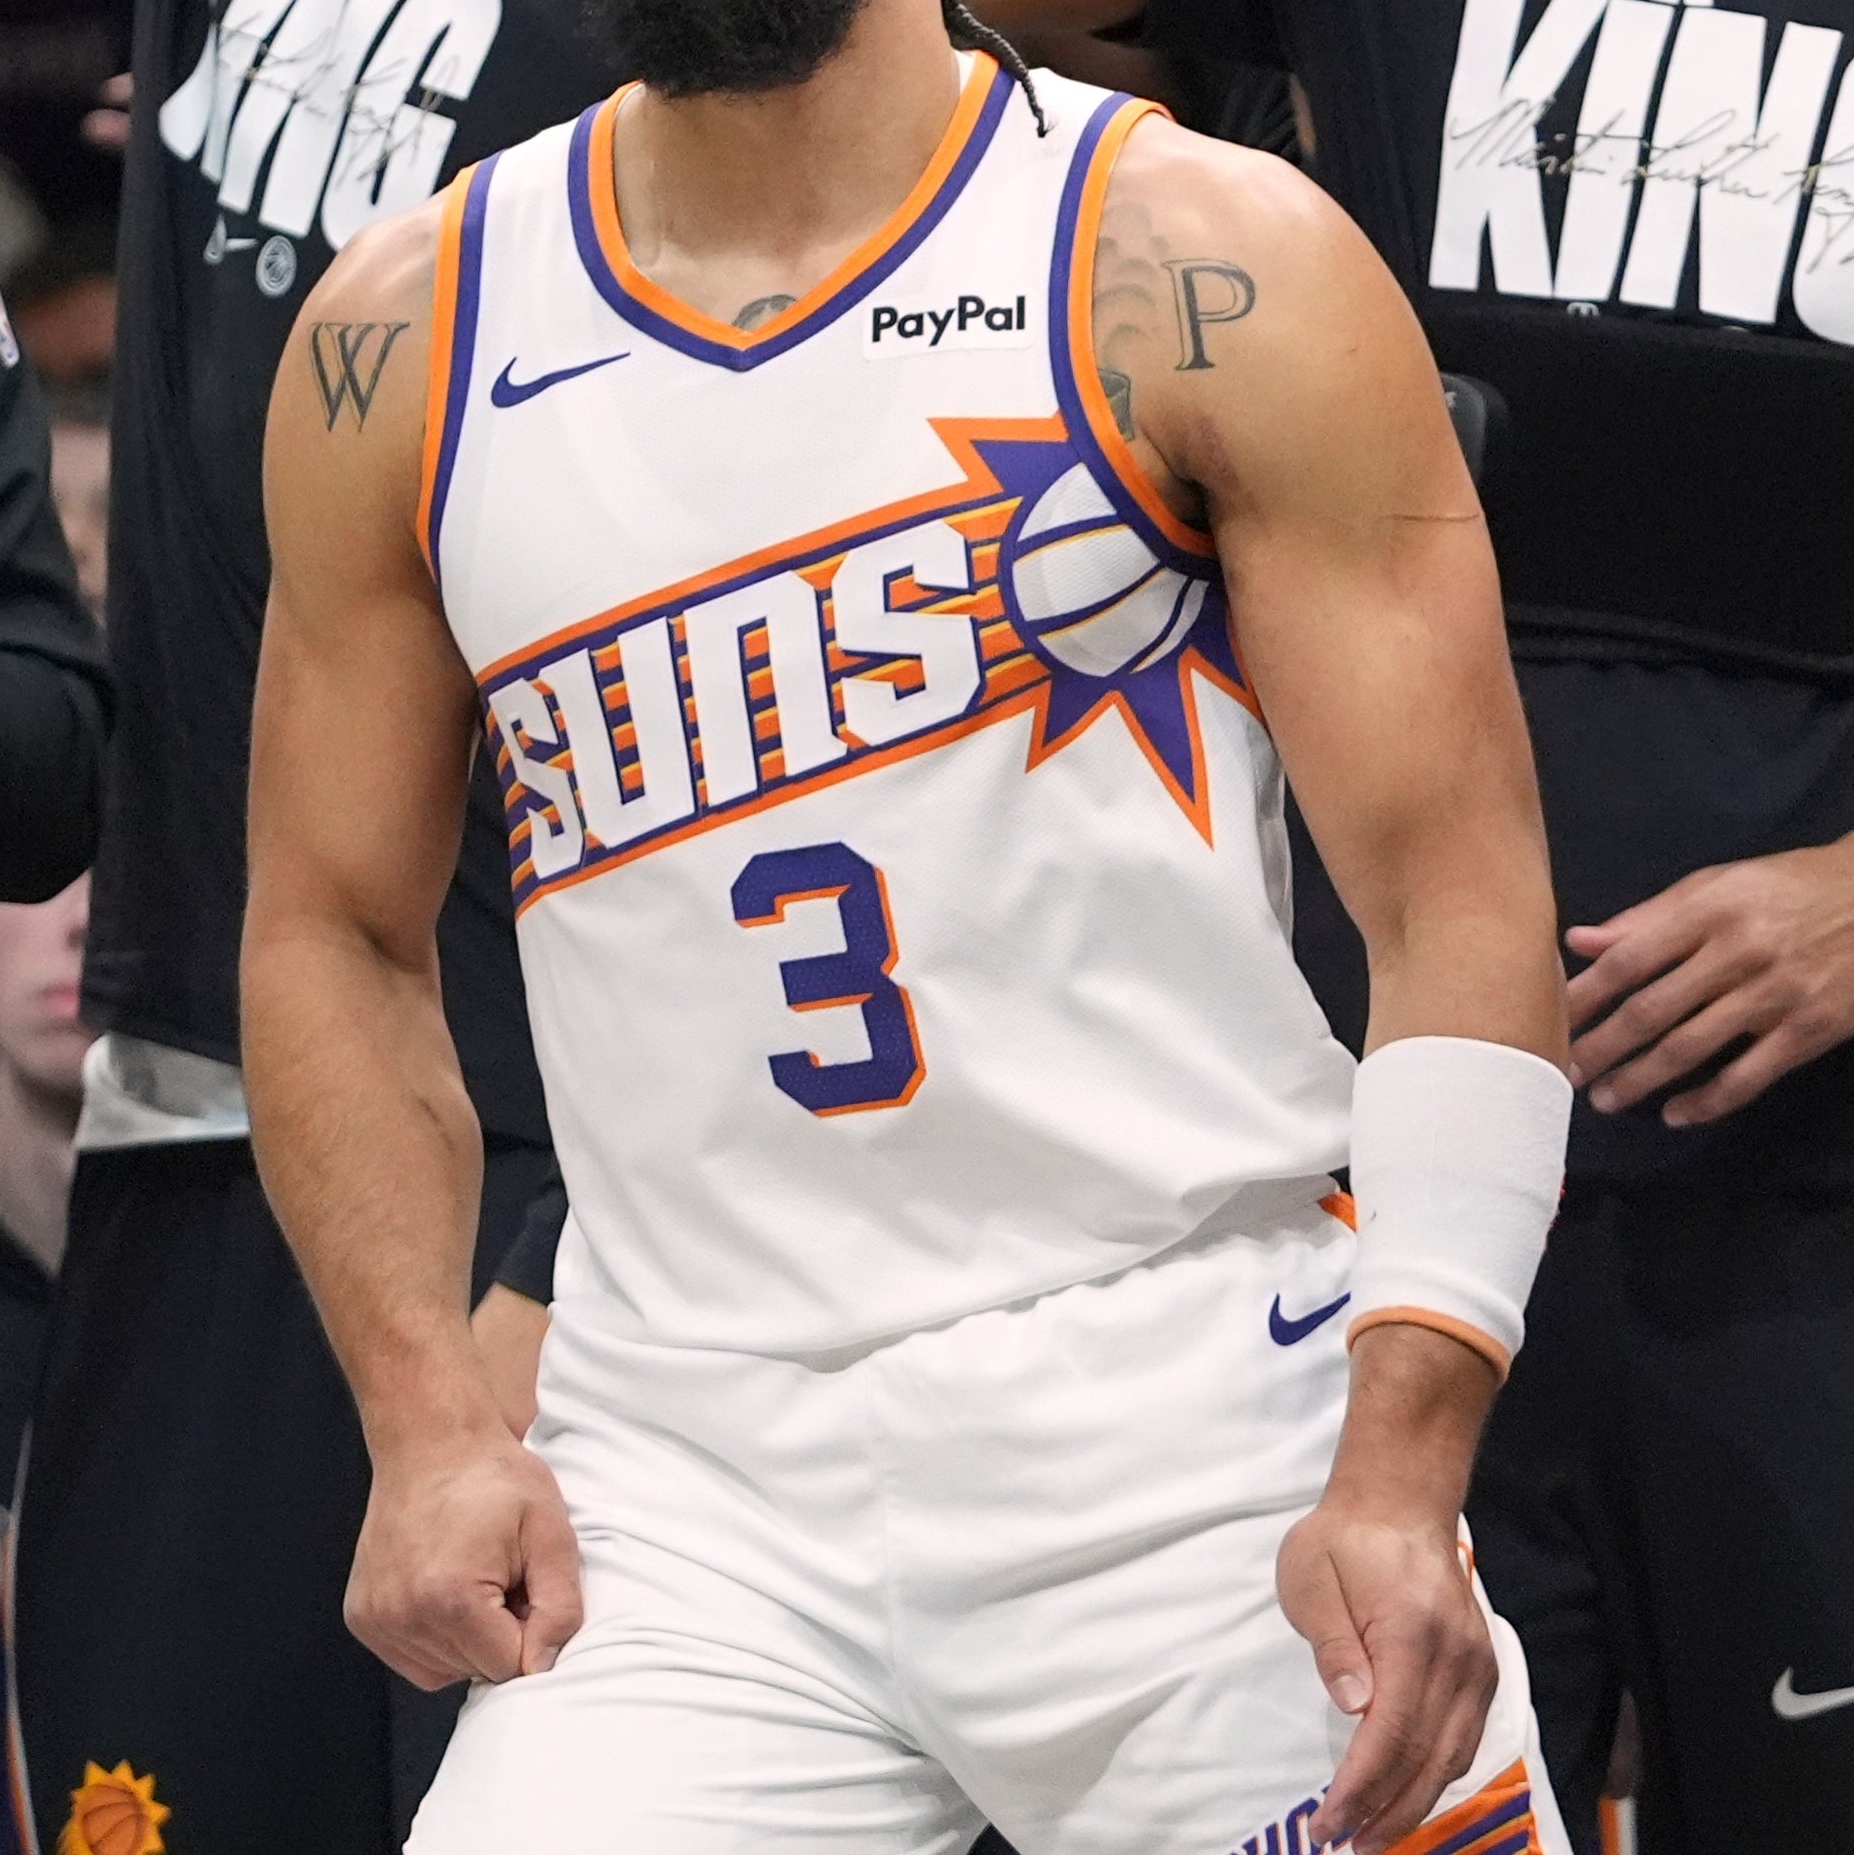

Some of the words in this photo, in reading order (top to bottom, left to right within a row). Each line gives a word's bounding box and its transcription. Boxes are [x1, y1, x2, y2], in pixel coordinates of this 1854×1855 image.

[871, 294, 1027, 347] PayPal
[1161, 258, 1257, 373] P
[311, 320, 411, 434] W
[488, 519, 986, 880] SUNS
[730, 841, 925, 1119] 3
